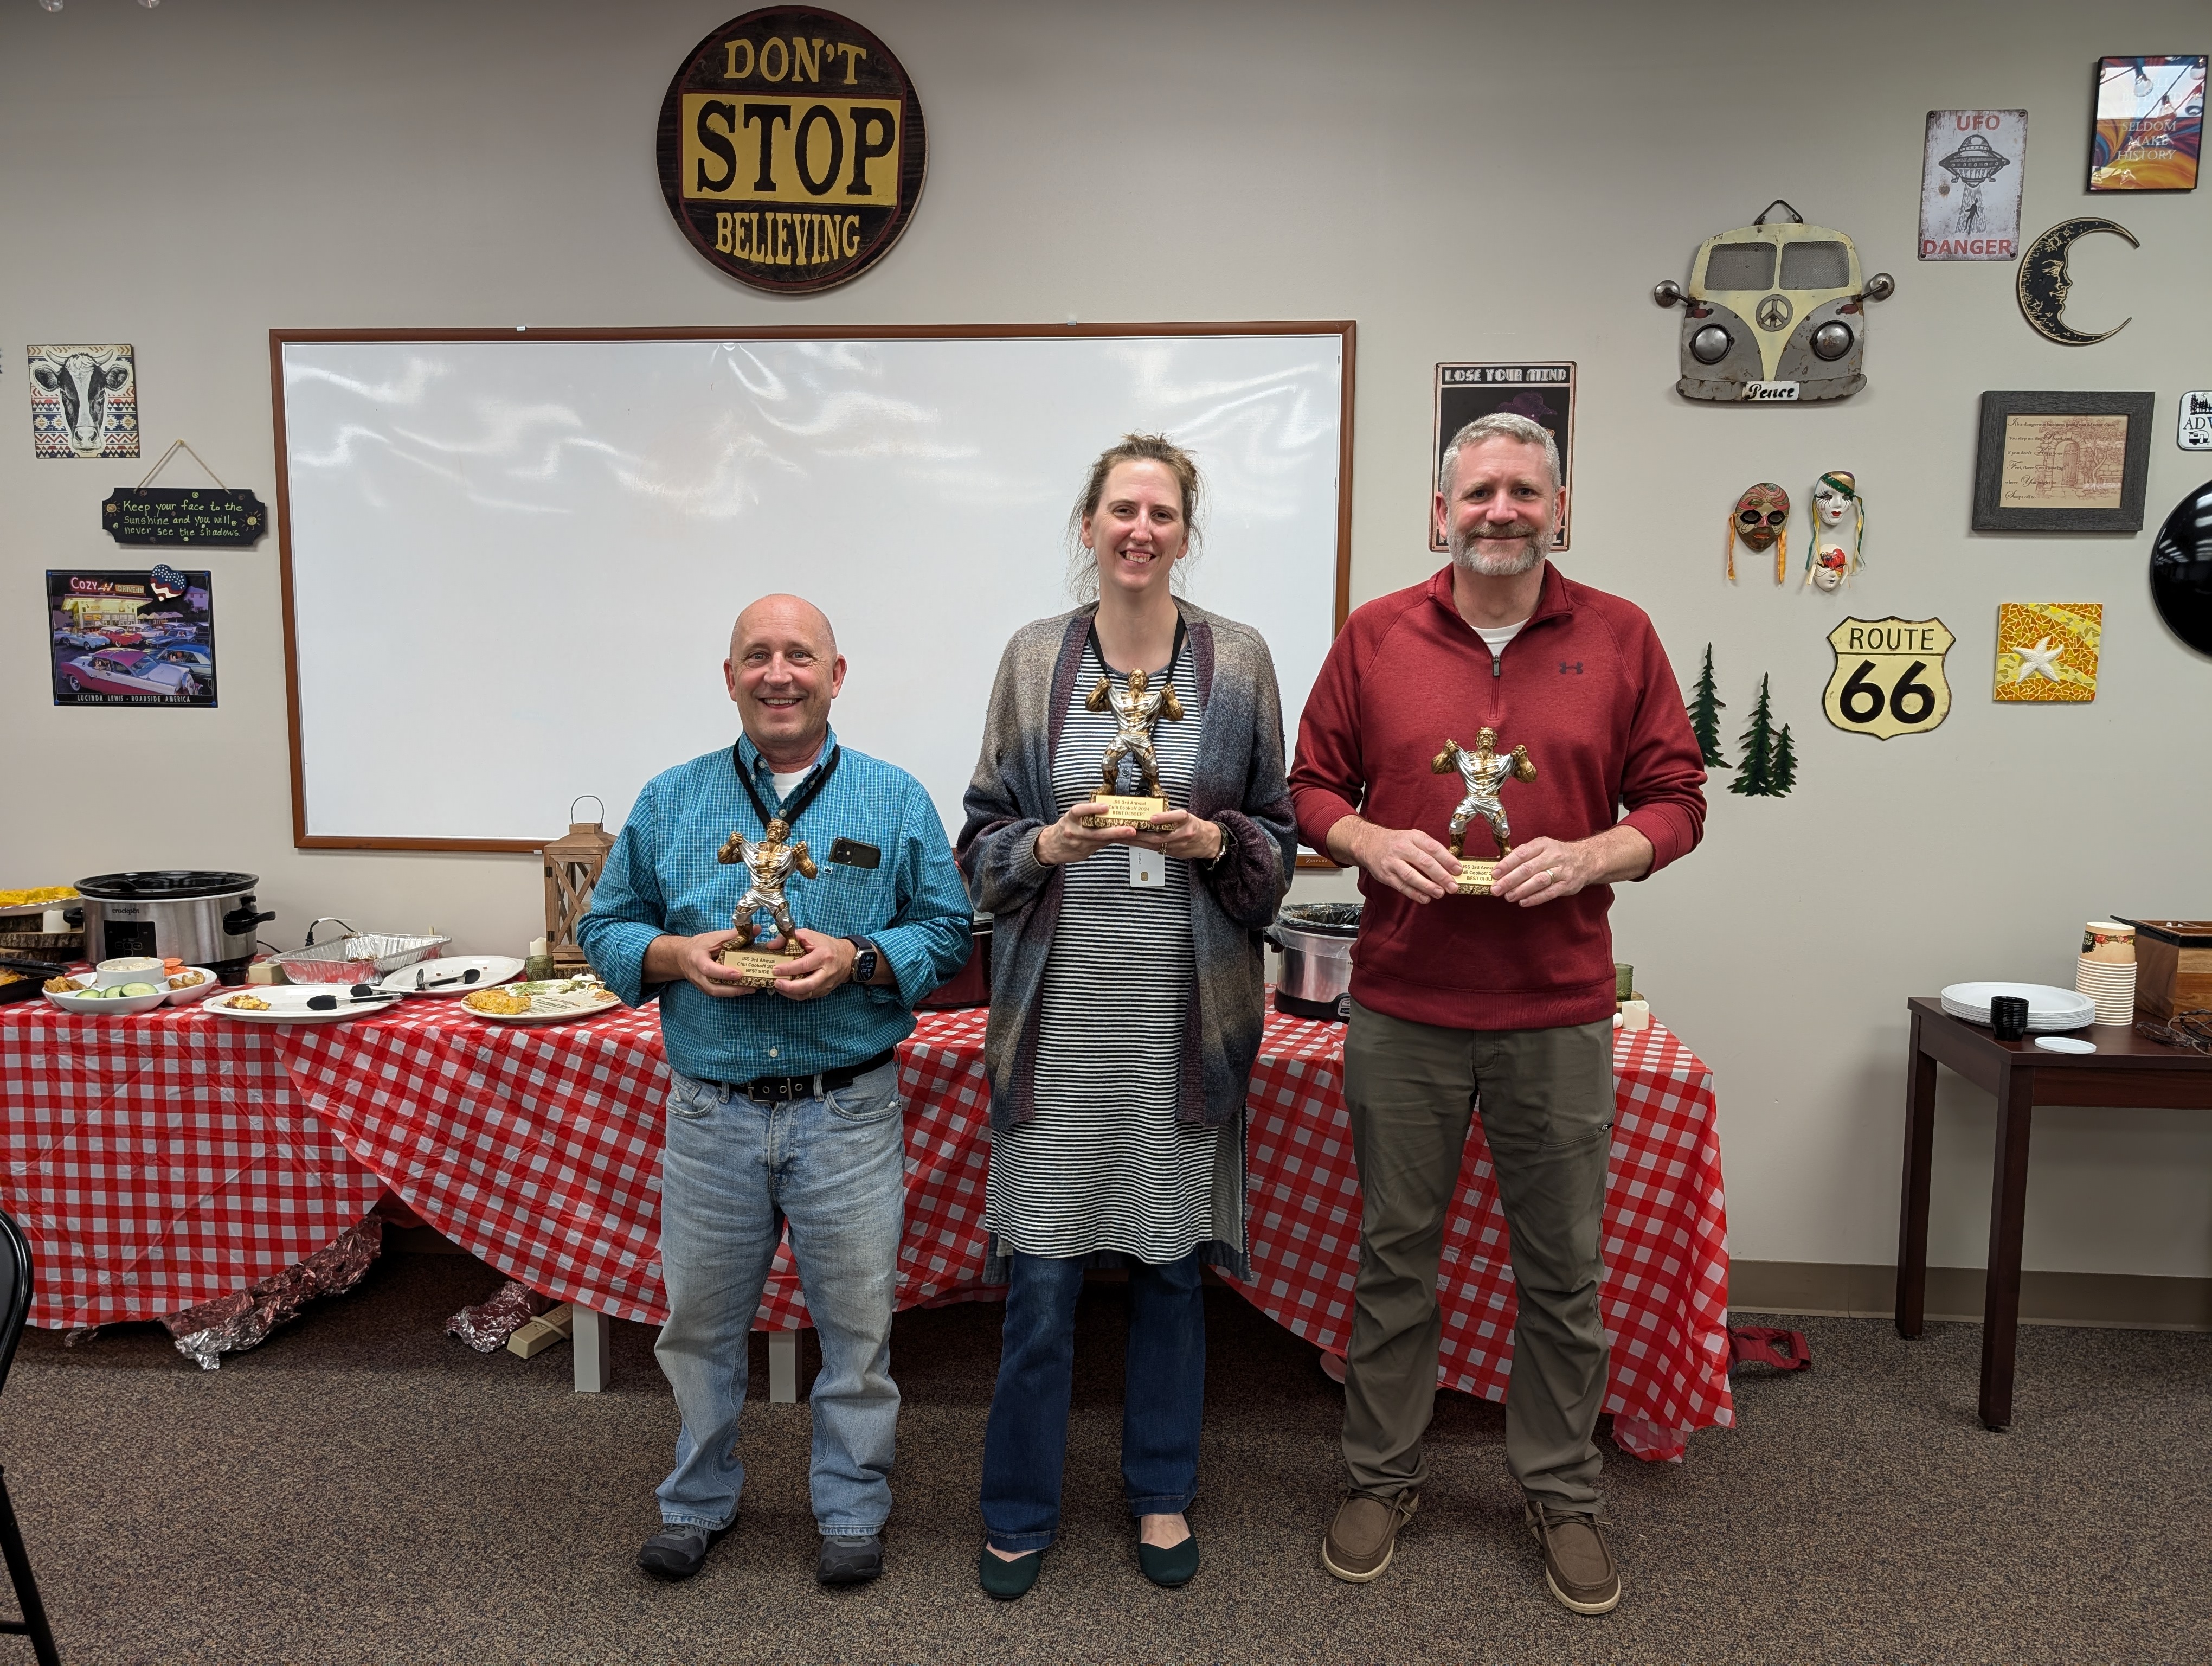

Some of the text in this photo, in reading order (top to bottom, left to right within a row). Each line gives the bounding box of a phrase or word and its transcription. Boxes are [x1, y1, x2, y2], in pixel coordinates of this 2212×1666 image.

[724, 37, 866, 84] DON'T
[1956, 115, 2000, 131] UFO
[2121, 121, 2176, 131] SELDOM
[697, 100, 896, 196] STOP
[2129, 136, 2168, 145] MAKE
[2117, 150, 2176, 160] HISTORY
[715, 212, 860, 265] BELIEVING
[1924, 239, 2012, 255] DANGER
[1445, 369, 1566, 381] LOSE YOUR MIND
[1746, 383, 1795, 399] Peace
[123, 500, 243, 517] Keep your face to the
[173, 515, 190, 524] and
[195, 516, 210, 526] you
[214, 515, 230, 524] will
[180, 528, 195, 536] the
[118, 586, 144, 594] DRIVE-IN
[1849, 627, 1934, 650] ROUTE
[1840, 659, 1935, 724] 66
